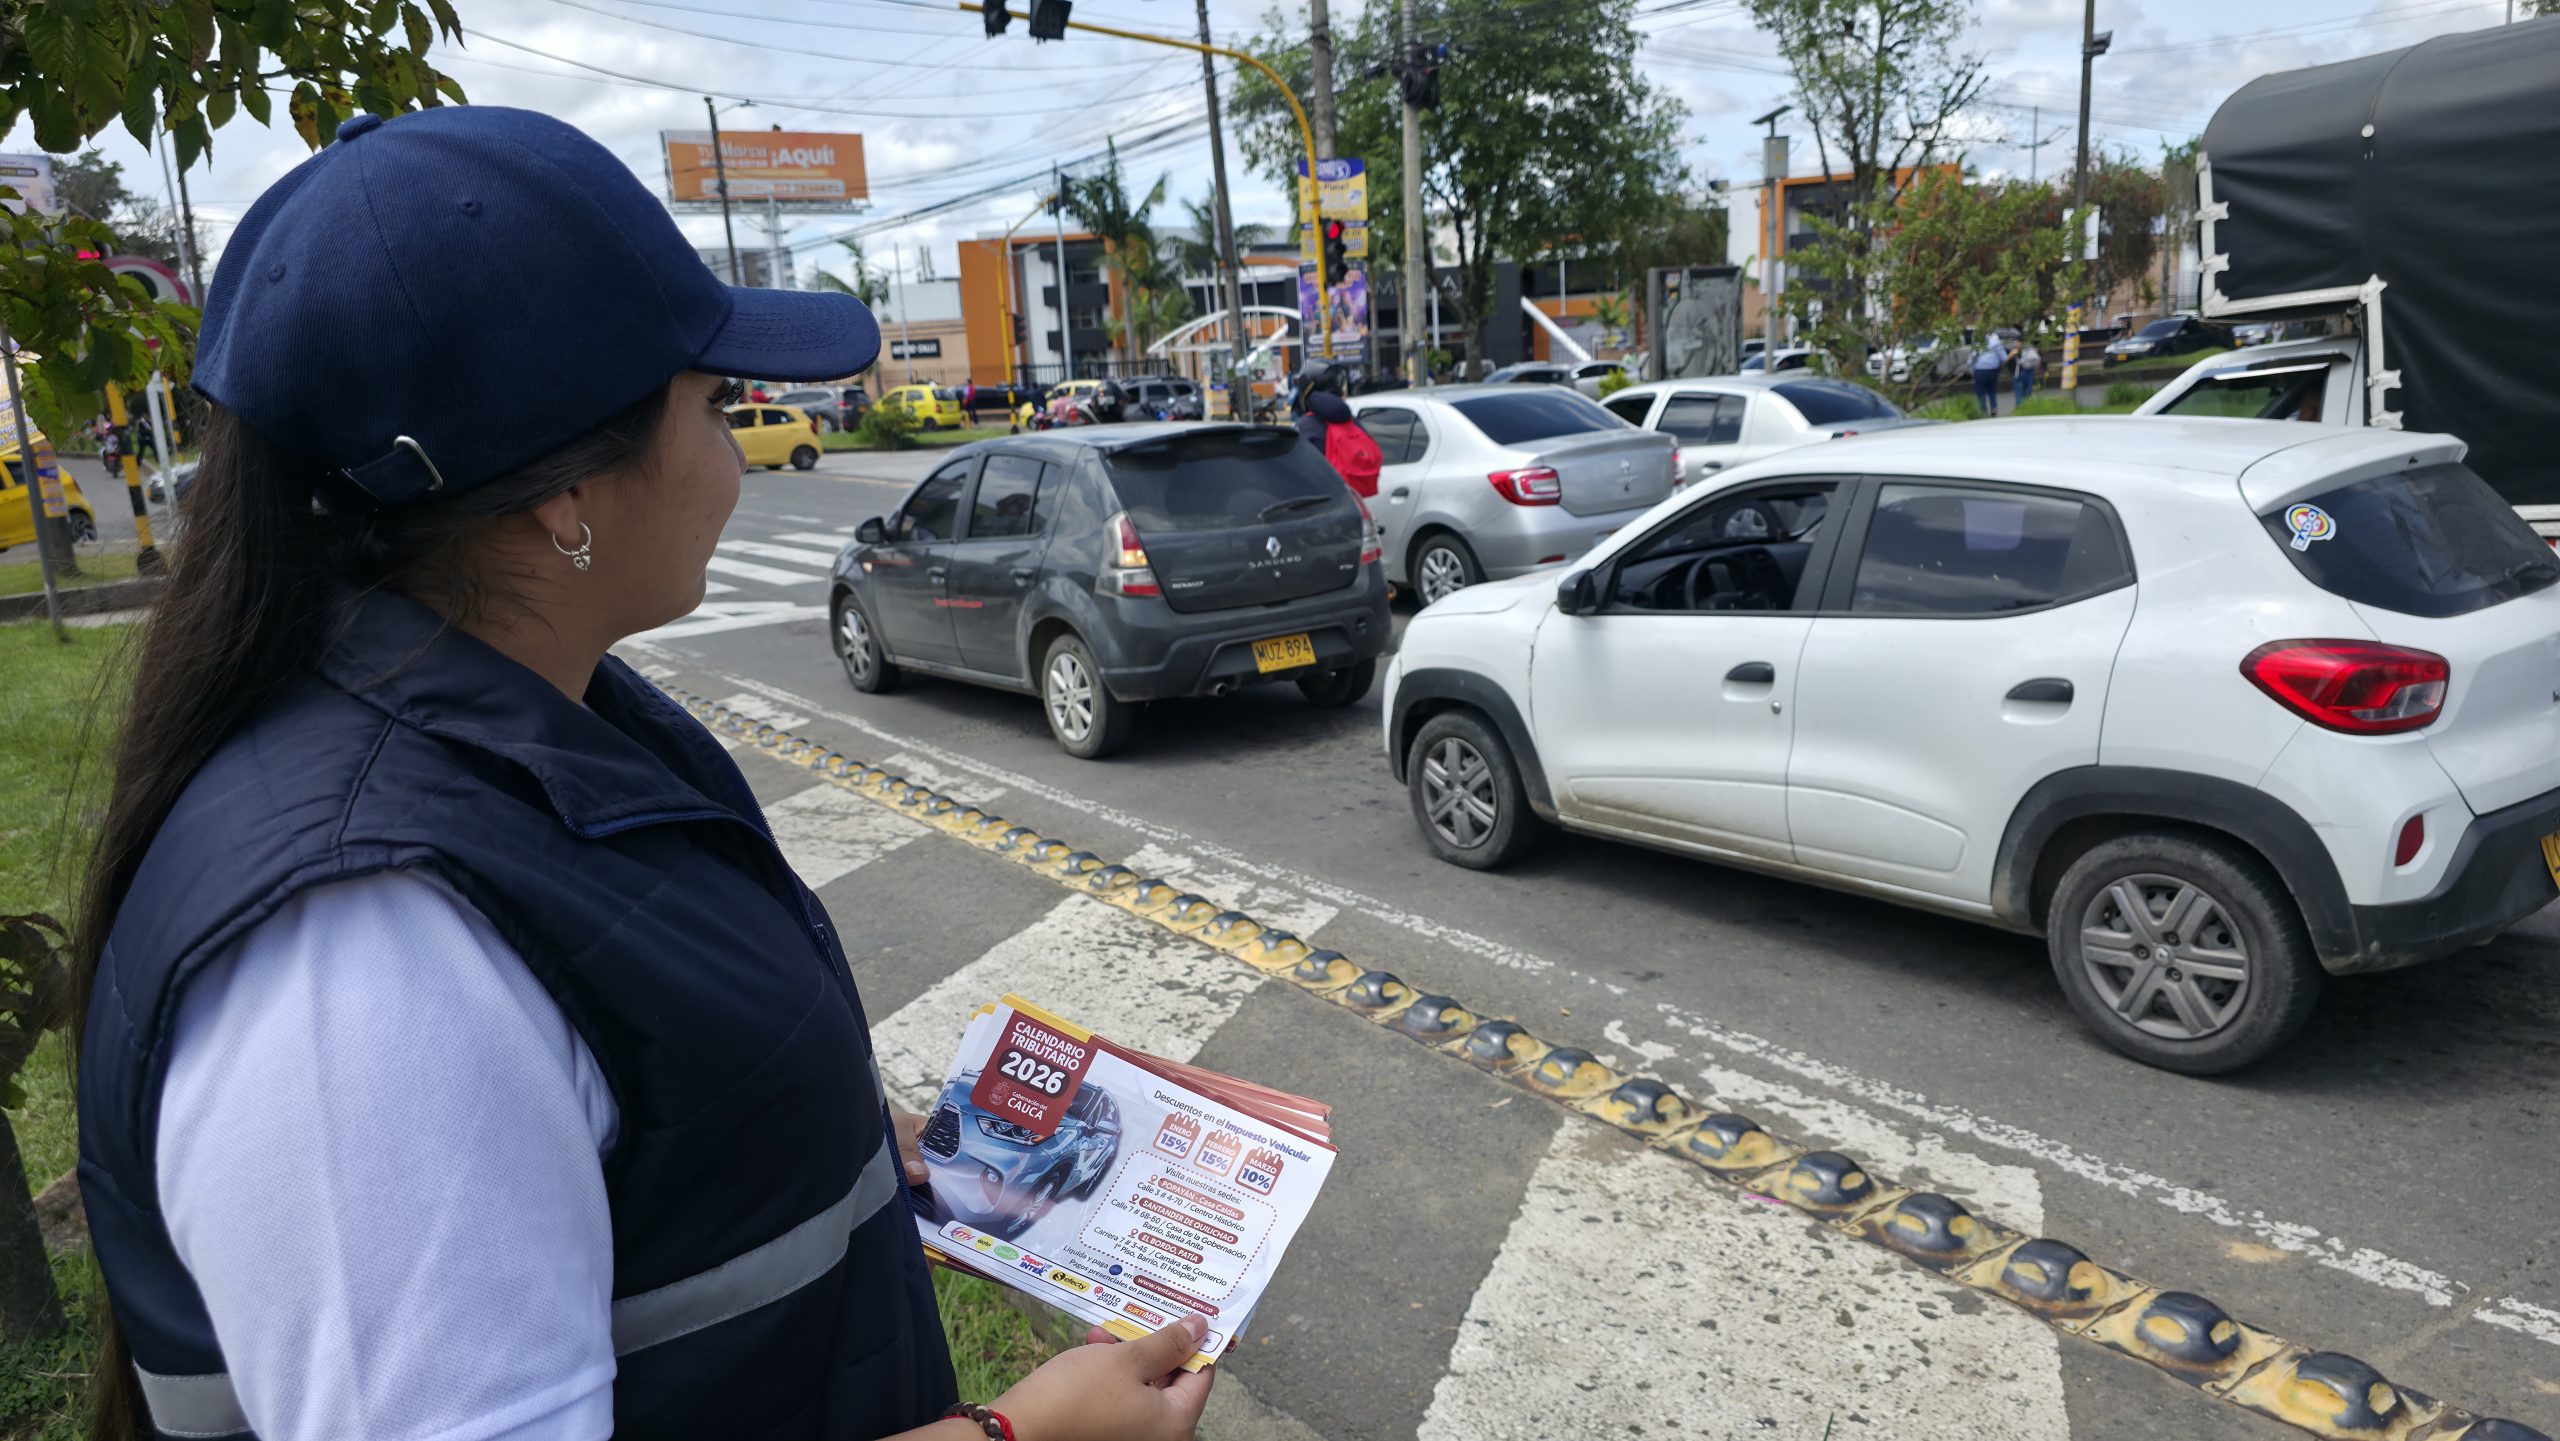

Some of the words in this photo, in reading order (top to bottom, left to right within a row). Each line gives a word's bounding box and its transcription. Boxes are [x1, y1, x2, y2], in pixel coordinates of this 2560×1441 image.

[770, 144, 835, 168] ¡AQUÍ!
[1248, 554, 1302, 569] SANDERO
[1256, 642, 1284, 662] MUZ
[1285, 637, 1310, 657] 894
[1010, 1032, 1079, 1070] TRIBUTARIO
[1016, 1022, 1086, 1059] CALENDARIO
[1001, 1052, 1065, 1094] 2026
[1008, 1098, 1043, 1120] CAUCA
[1012, 1091, 1040, 1107] Gobernación
[1040, 1103, 1048, 1111] del
[1154, 1090, 1202, 1117] Descuentos
[1204, 1113, 1215, 1123] en
[1216, 1118, 1225, 1126] el
[1225, 1120, 1267, 1144] Impuesto
[1269, 1138, 1311, 1163] Vehicular
[1169, 1123, 1192, 1138] ENERO
[1160, 1132, 1186, 1153] 15%
[1206, 1141, 1236, 1156] FEBRERO
[1201, 1150, 1227, 1170] 15%
[1249, 1158, 1277, 1174] MARZO
[1165, 1166, 1184, 1180] Visita
[1186, 1176, 1216, 1194] nuestras
[1218, 1190, 1242, 1204] sedes:
[1242, 1167, 1269, 1189] 10%
[1138, 1182, 1154, 1193] Calle
[1155, 1188, 1160, 1196] 3
[1167, 1193, 1184, 1205] 4-70
[1190, 1205, 1213, 1219] Centro
[1214, 1215, 1245, 1232] Histórico
[1162, 1181, 1195, 1200] POPAYÁN
[1200, 1196, 1215, 1208] Casa
[1216, 1202, 1239, 1219] Caldas
[1111, 1199, 1128, 1210] Calle
[1166, 1222, 1182, 1233] Casa
[1183, 1229, 1194, 1238] de
[1201, 1236, 1247, 1260] Gobernación
[1142, 1200, 1184, 1221] SANTANDER
[1184, 1216, 1193, 1226] DE
[1194, 1222, 1234, 1242] QUILICHAO
[1142, 1221, 1164, 1236] Barrio,
[1165, 1230, 1185, 1244] Santa
[1185, 1239, 1204, 1251] Anita
[1094, 1226, 1118, 1241] Carrera
[1131, 1242, 1148, 1253] 3-45
[1182, 1263, 1192, 1272] de
[1192, 1268, 1227, 1286] Comercio
[1142, 1234, 1150, 1242] EL
[1151, 1238, 1177, 1254] BORDO,
[1178, 1248, 1198, 1262] PATÍA
[1120, 1246, 1135, 1258] Piso,
[1137, 1253, 1158, 1268] Barrio,
[1167, 1267, 1198, 1282] Hospital
[1064, 1277, 1086, 1290] efecty
[1069, 1259, 1089, 1271] Pagos
[1088, 1268, 1128, 1288] presenciales
[1137, 1290, 1160, 1303] puntos
[1092, 1258, 1109, 1269] paga
[1137, 1278, 1213, 1313] www.rentascauca.gov.co
